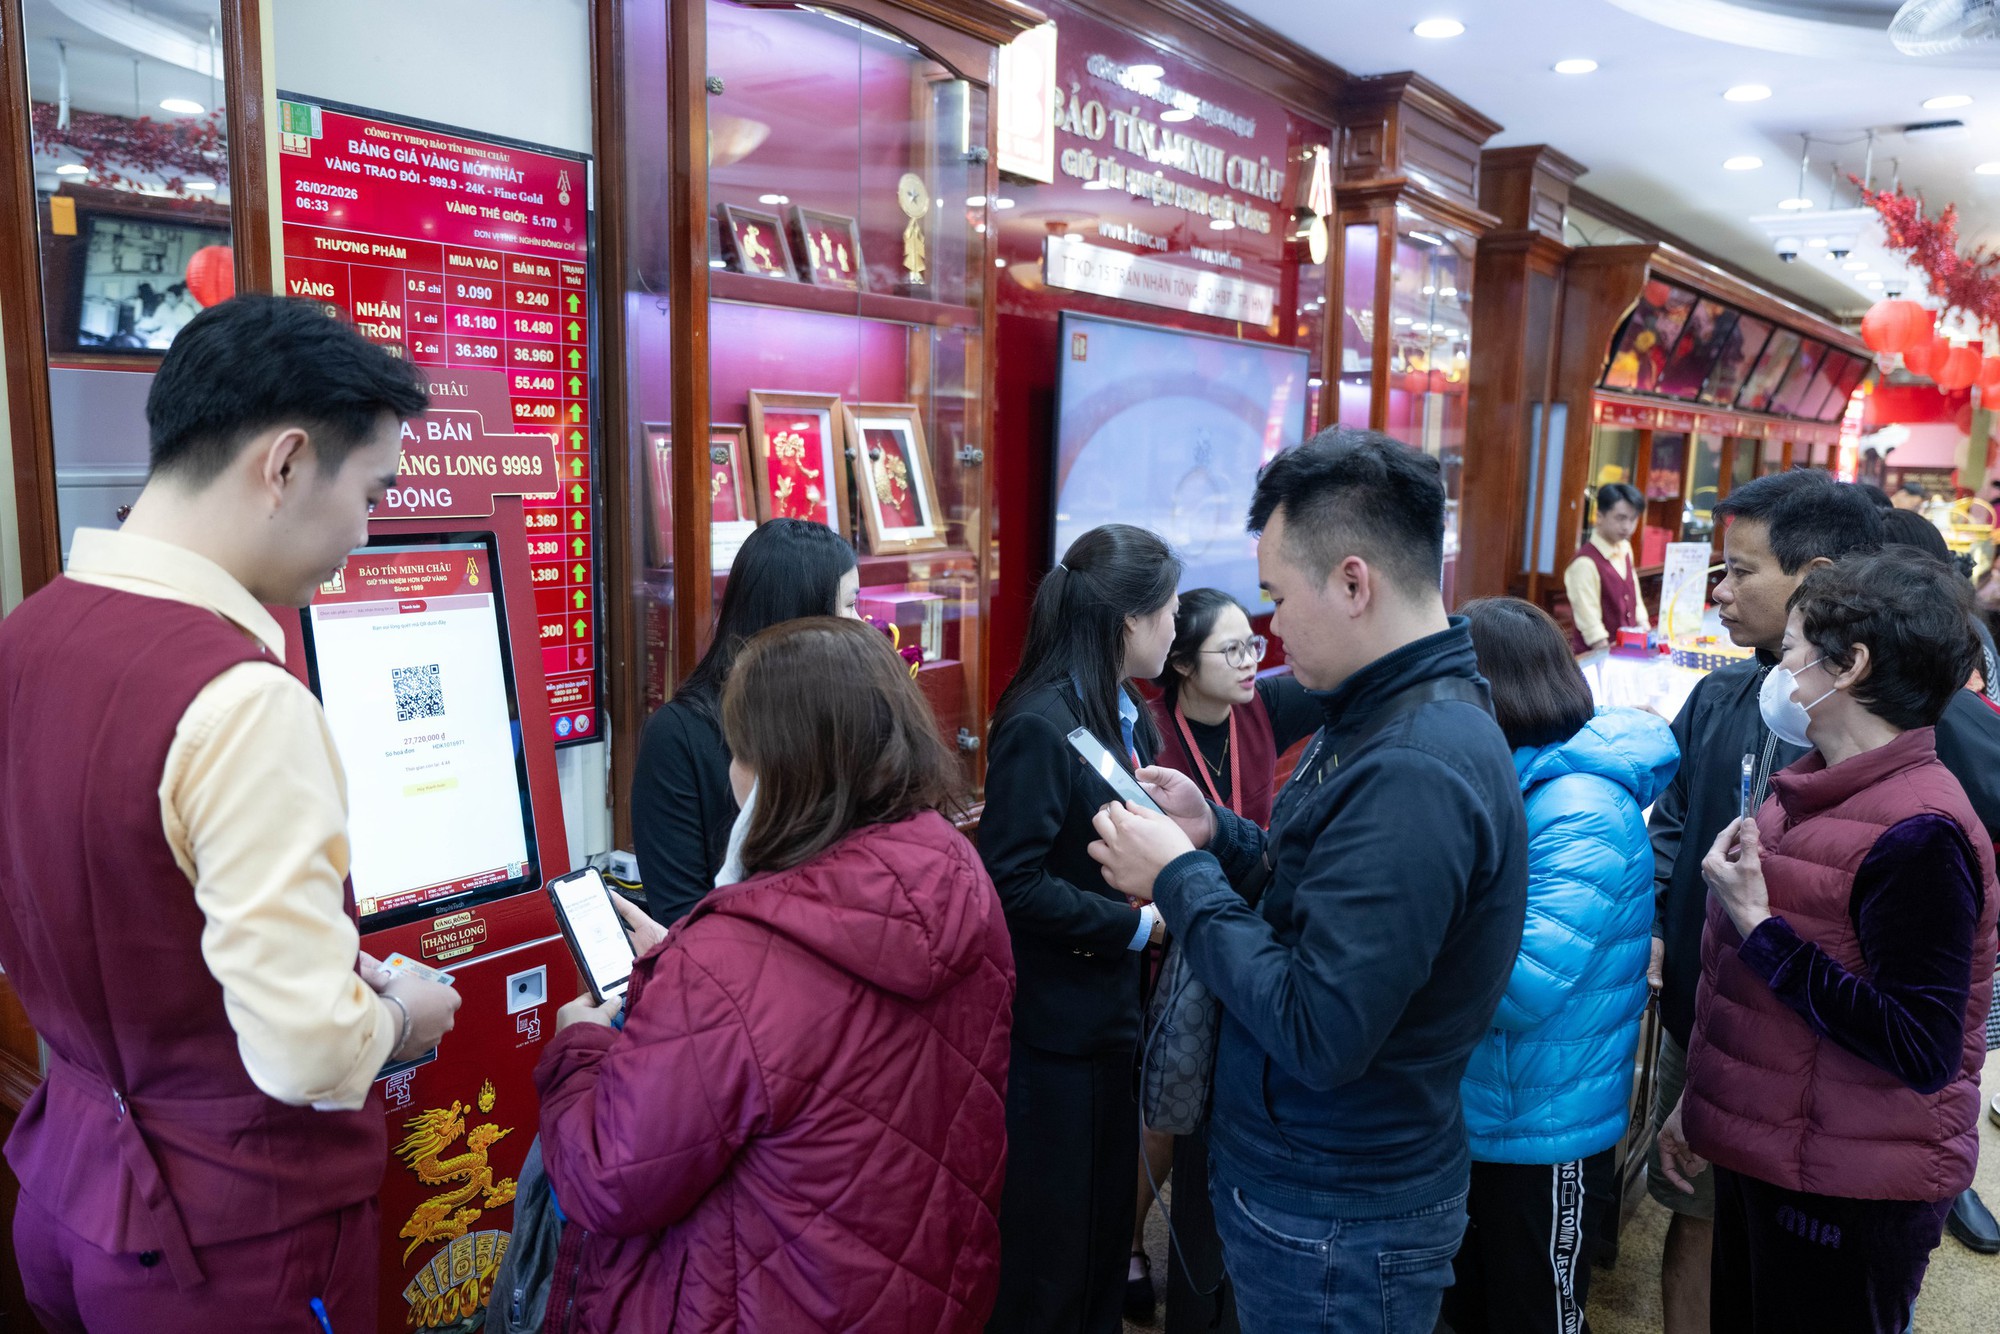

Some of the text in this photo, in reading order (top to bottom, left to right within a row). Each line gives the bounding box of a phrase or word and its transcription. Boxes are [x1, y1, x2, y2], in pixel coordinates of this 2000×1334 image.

[391, 132, 403, 141] TY
[463, 147, 487, 158] MINH
[487, 150, 510, 162] CHÂU
[1054, 81, 1107, 141] BẢO
[1108, 105, 1158, 163] TÍN
[1157, 126, 1225, 185] MINH
[1226, 154, 1286, 204] CHÂU
[348, 139, 391, 160] BẢNG
[393, 148, 418, 165] GIÁ
[421, 152, 459, 172] VÀNG
[324, 156, 361, 173] VÀNG
[364, 164, 397, 179] TRAO
[429, 175, 457, 190] 999.9
[465, 182, 486, 195] 24K
[494, 187, 517, 200] Fine
[519, 192, 544, 205] Gold
[295, 180, 358, 200] 26/02/2026
[295, 196, 329, 212] 06:33
[446, 200, 477, 216] VÀNG
[532, 215, 557, 229] 5.170
[1098, 220, 1169, 252] www.btmc.vn
[449, 254, 499, 270] MUA VÀO
[513, 262, 551, 278] BÁN RA
[290, 277, 335, 297] VÀNG
[408, 280, 426, 292] 0.5
[457, 284, 493, 301] 9.090
[515, 290, 549, 307] 9.240
[414, 311, 421, 322] 1
[454, 313, 497, 331] 18.180
[357, 321, 401, 339] TRÒN
[513, 319, 553, 335] 18.480
[415, 341, 423, 353] 2
[455, 342, 498, 359] 36.360
[514, 347, 554, 364] 36.960
[429, 380, 469, 396] CHÂU
[514, 375, 555, 391] 55.440
[515, 402, 556, 418] 92.400
[400, 418, 472, 443] A, BÁN
[397, 449, 543, 476] ĂNG LONG 999.9
[386, 486, 453, 513] ĐỘNG
[525, 514, 558, 528] 8.360
[528, 542, 558, 555] 8.380
[359, 561, 452, 577] BẢO TÍN MINH CHÂU
[423, 924, 484, 949] THĂNG LONG
[1558, 1207, 1575, 1251] TOMMY
[1564, 1309, 1578, 1334] TOM
